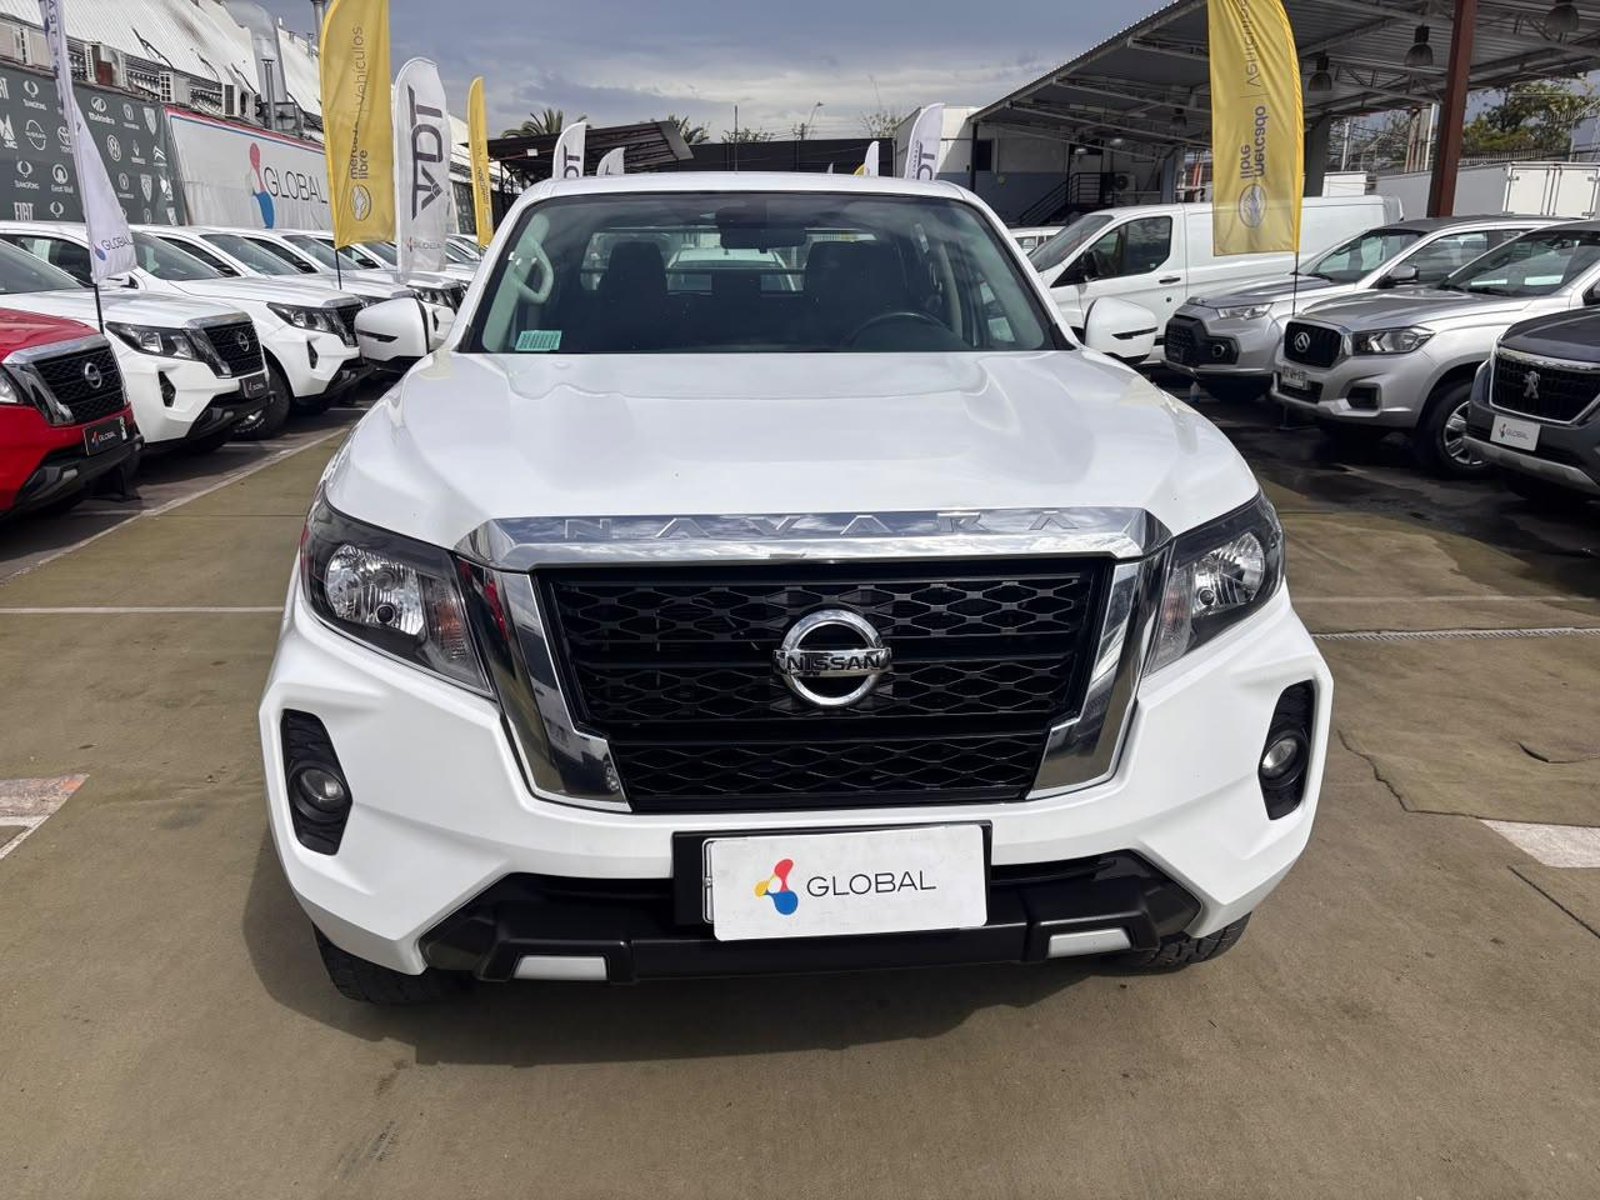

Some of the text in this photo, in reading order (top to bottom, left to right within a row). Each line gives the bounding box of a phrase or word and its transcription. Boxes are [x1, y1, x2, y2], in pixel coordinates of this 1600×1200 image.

[359, 150, 368, 180] libre
[263, 167, 328, 204] GLOBAL
[14, 202, 34, 221] FIAT
[564, 510, 1080, 540] NAVARA
[786, 654, 881, 671] NISSAN
[806, 870, 937, 897] GLOBAL
